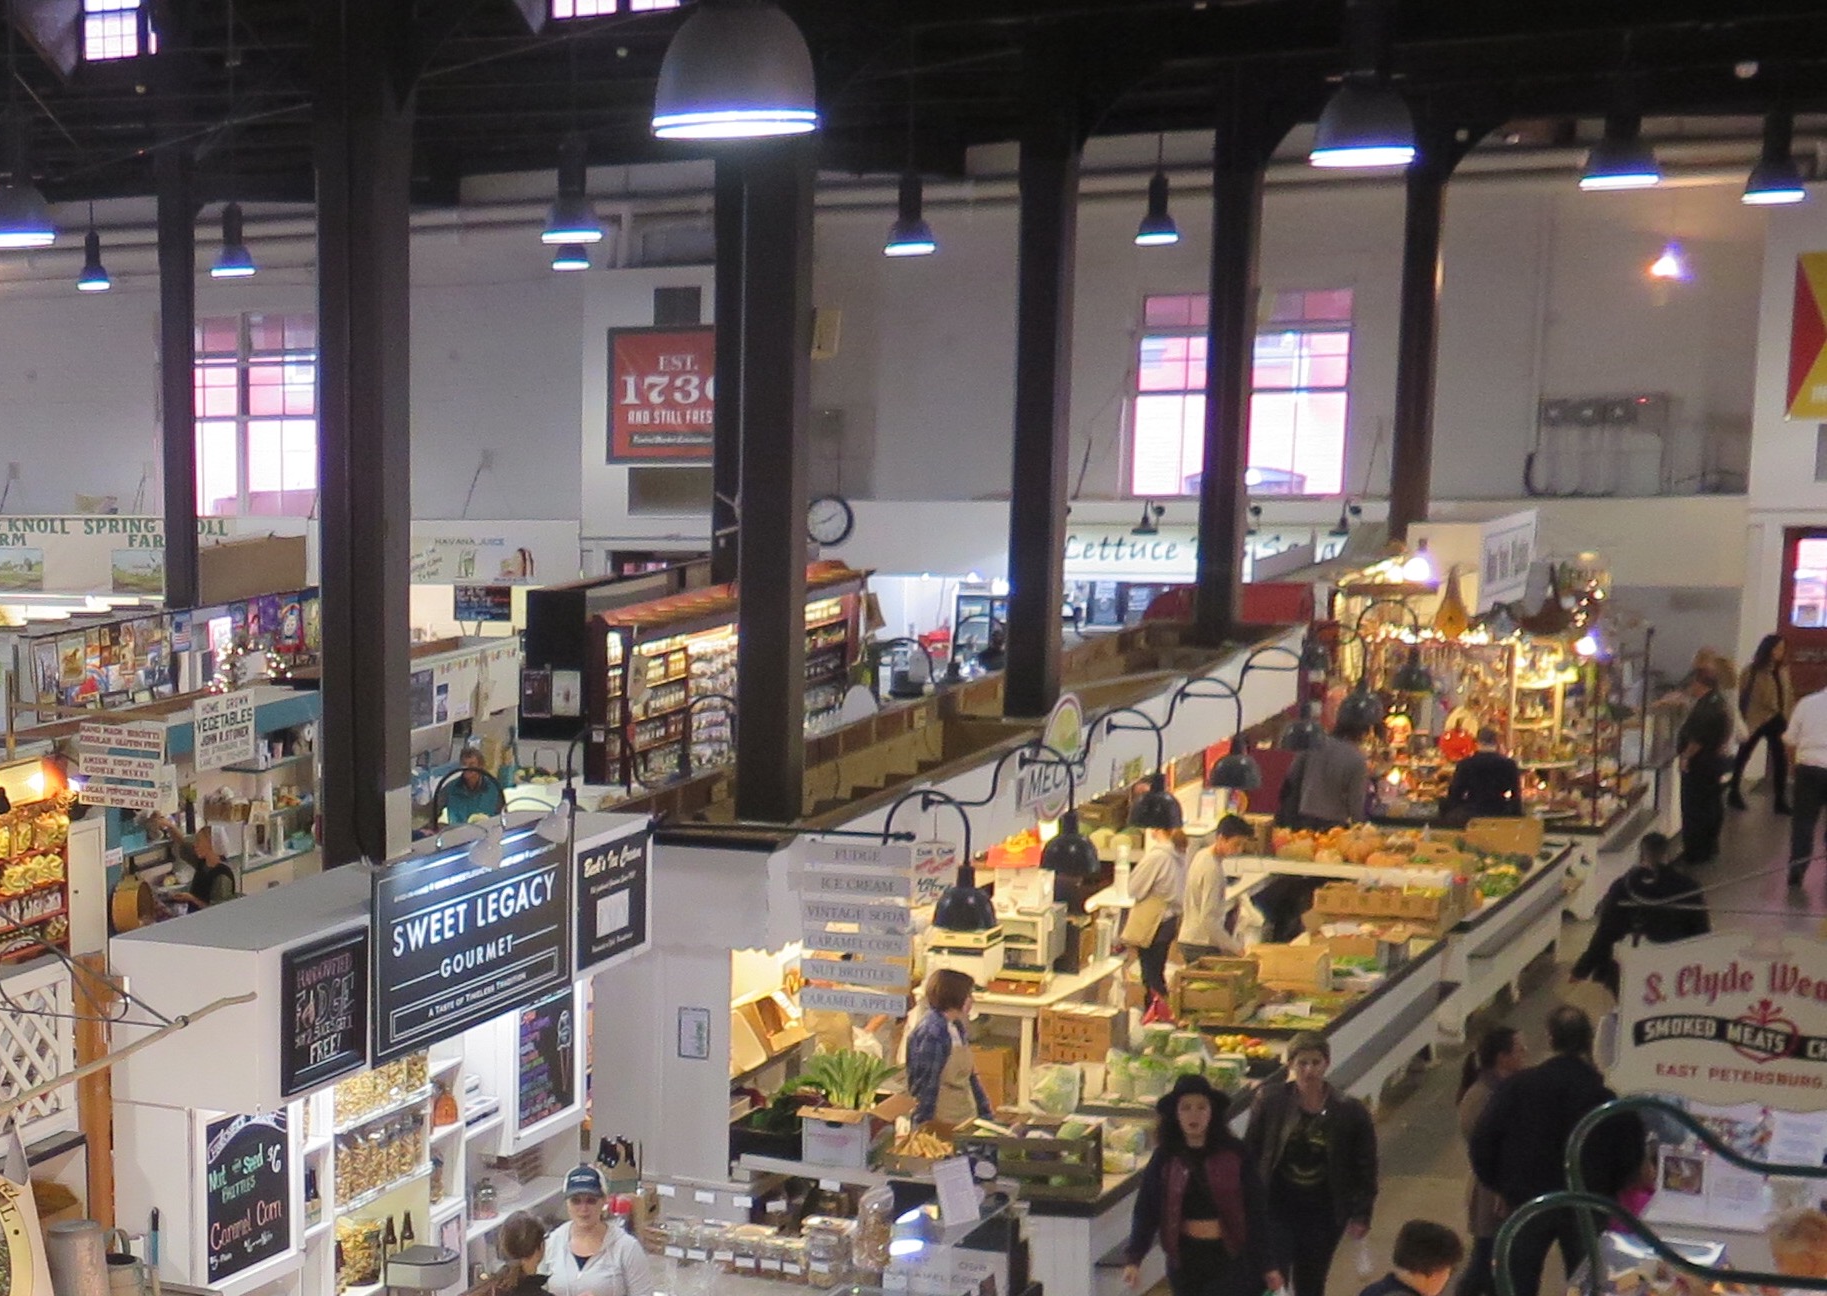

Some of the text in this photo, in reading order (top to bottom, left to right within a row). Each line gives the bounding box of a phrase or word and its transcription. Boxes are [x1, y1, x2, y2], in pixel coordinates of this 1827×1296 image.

[659, 354, 698, 371] EST.
[627, 411, 650, 424] AND
[653, 411, 683, 424] STILL
[7, 516, 70, 534] KNOLL
[84, 516, 157, 535] SPRING
[1064, 535, 1177, 562] Lettuce
[196, 708, 253, 734] VEGETABLES
[137, 760, 155, 770] AND
[140, 789, 158, 799] AND
[834, 850, 882, 863] FUDGE
[821, 877, 896, 893] ICE CREAM
[392, 903, 468, 958] SWEET
[476, 871, 557, 928] LEGACY
[807, 905, 907, 923] VINTAGE SODA
[807, 935, 903, 951] CARAMEL CORN
[439, 934, 516, 979] GOURMET
[811, 964, 895, 981] NUT BRITTLES
[1675, 960, 1755, 1005] Clyde
[428, 1005, 434, 1018] A
[800, 994, 903, 1011] CARAMEL APPLES
[1644, 1017, 1717, 1042] SMOKED
[1726, 1023, 1788, 1052] MEATS
[310, 1032, 343, 1065] FREE!
[1656, 1063, 1699, 1079] EAST
[208, 1164, 228, 1193] Nut
[243, 1142, 264, 1175] Seed
[222, 1174, 257, 1204] BRITTLES
[210, 1199, 283, 1251] Caramel Corn
